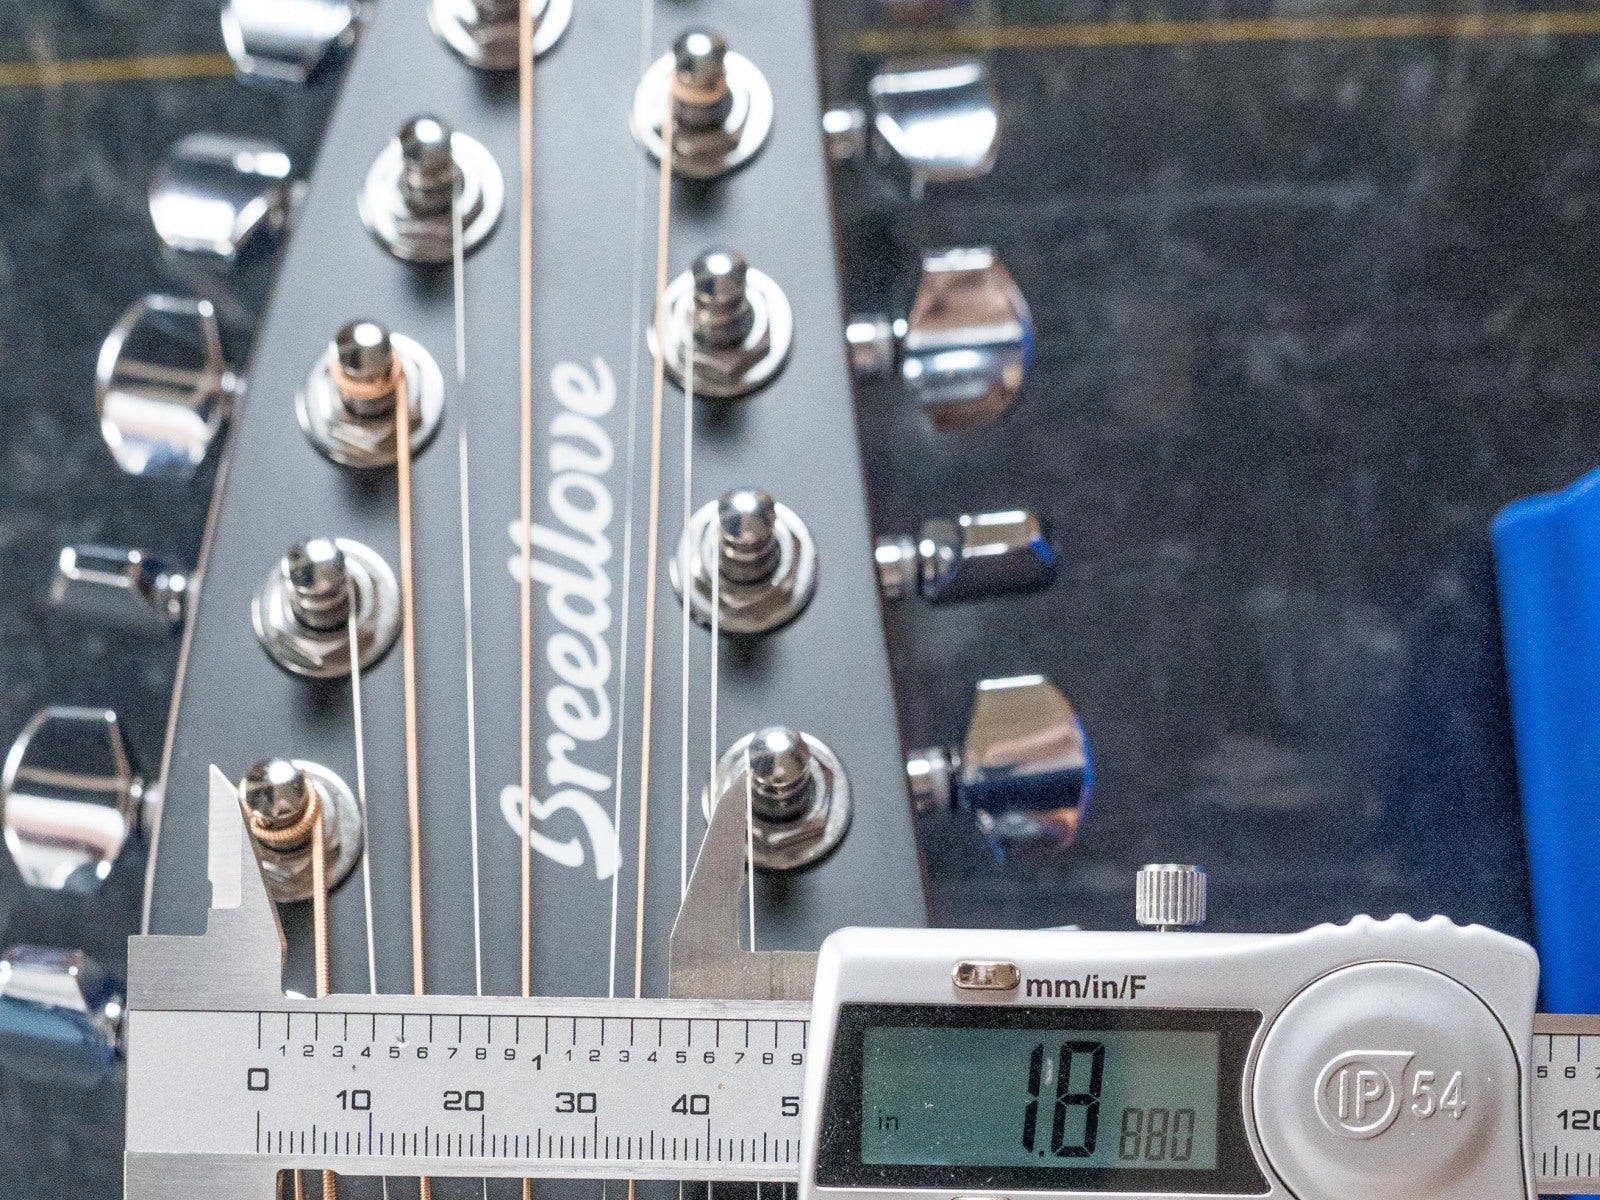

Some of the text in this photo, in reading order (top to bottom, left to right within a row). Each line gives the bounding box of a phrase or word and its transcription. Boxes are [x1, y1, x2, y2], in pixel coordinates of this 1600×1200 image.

[499, 356, 623, 880] Breedlove
[1026, 974, 1147, 1000] mm/in/F
[279, 1045, 802, 1071] 1 2 3 4 5 6 7 8 9 1 1 2 3 4 5 6 7 8 9
[1536, 1065, 1576, 1079] 5 6
[247, 1067, 800, 1117] 0 10 20 30 40 5
[1336, 1067, 1468, 1125] IP 54
[877, 1112, 899, 1133] in
